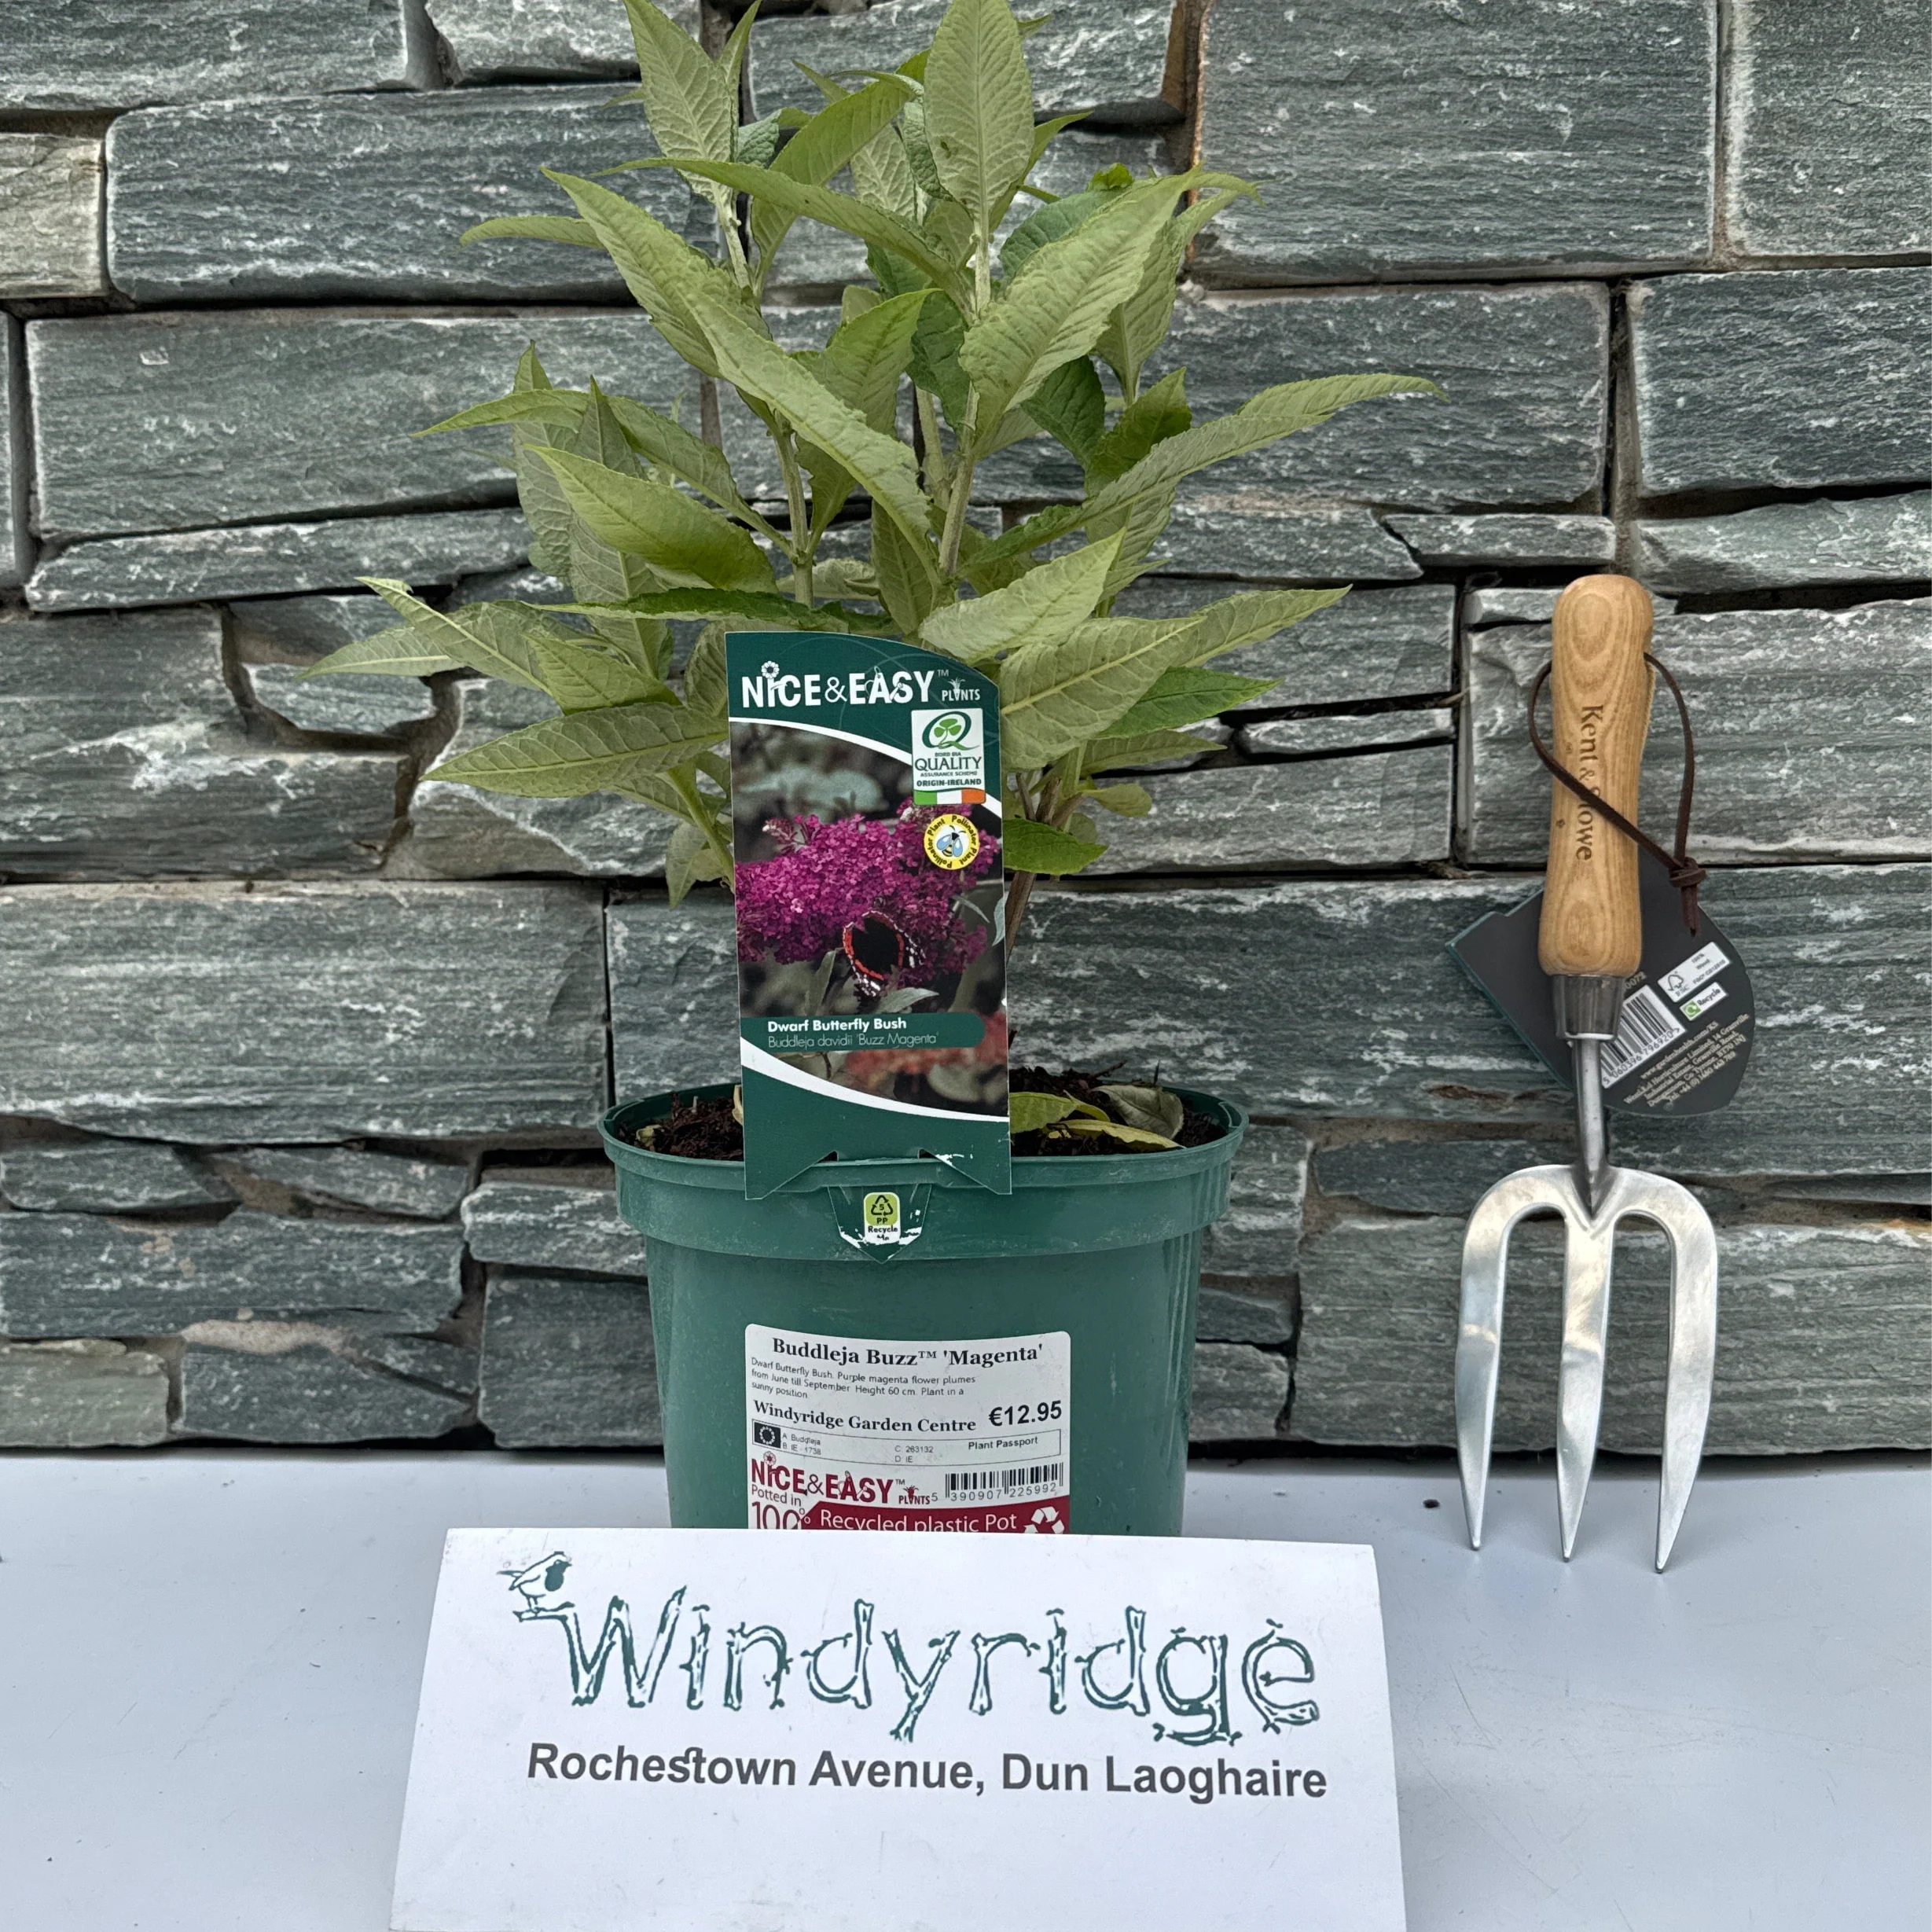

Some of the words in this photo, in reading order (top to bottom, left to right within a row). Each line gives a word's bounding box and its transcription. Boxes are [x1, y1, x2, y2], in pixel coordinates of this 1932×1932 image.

[942, 683, 981, 702] PLANTS
[1580, 705, 1603, 762] Kent
[915, 757, 982, 772] QUALITY
[1580, 766, 1595, 781] &
[916, 778, 982, 787] ORIGIN-IRELAND
[927, 818, 946, 836] Plant
[952, 815, 977, 845] Pollinator
[927, 838, 953, 869] Pollinator
[958, 847, 977, 865] Plant
[1696, 986, 1721, 1006] Recycle
[768, 1019, 809, 1032] Dwarf
[813, 1019, 869, 1033] Butterfly
[874, 1017, 906, 1030] Bush
[768, 1034, 814, 1050] Buddleja
[817, 1034, 853, 1047] davidii
[1643, 1030, 1674, 1055] 796920
[868, 1225, 898, 1233] Recycle
[772, 1337, 861, 1366] Buddleja
[943, 1342, 1043, 1368] 'Magenta'
[751, 1357, 774, 1370] Dwarf
[776, 1362, 810, 1378] Butterfly
[837, 1372, 865, 1383] Purple
[869, 1376, 909, 1386] magenta
[912, 1376, 939, 1385] flower
[943, 1376, 976, 1384] plumes
[751, 1368, 769, 1380] from
[771, 1373, 788, 1384] June
[791, 1377, 802, 1387] till
[855, 1385, 885, 1397] Height
[888, 1387, 900, 1396] 60
[921, 1387, 944, 1396] Plant
[751, 1382, 774, 1394] sunny
[753, 1400, 844, 1430] Windyridge
[848, 1415, 913, 1432] Garden
[917, 1418, 977, 1432] Centre
[988, 1400, 1062, 1427] €12.95
[968, 1441, 994, 1450] Plant
[996, 1437, 1038, 1448] Passport
[751, 1484, 788, 1504] Potted
[791, 1494, 802, 1507] in
[898, 1490, 931, 1504] PLANTS
[931, 1493, 938, 1502] 5
[950, 1488, 1002, 1502] 390907
[1008, 1482, 1056, 1498] 225992
[821, 1509, 907, 1531] Recycled
[914, 1515, 979, 1532] plastic
[986, 1514, 1017, 1531] Pot
[519, 1585, 1320, 1747] Windyridge
[527, 1742, 796, 1786] Rochestown
[808, 1750, 985, 1796] Avenue,
[1001, 1753, 1089, 1791] Dun
[1105, 1755, 1327, 1805] Laoghaire
